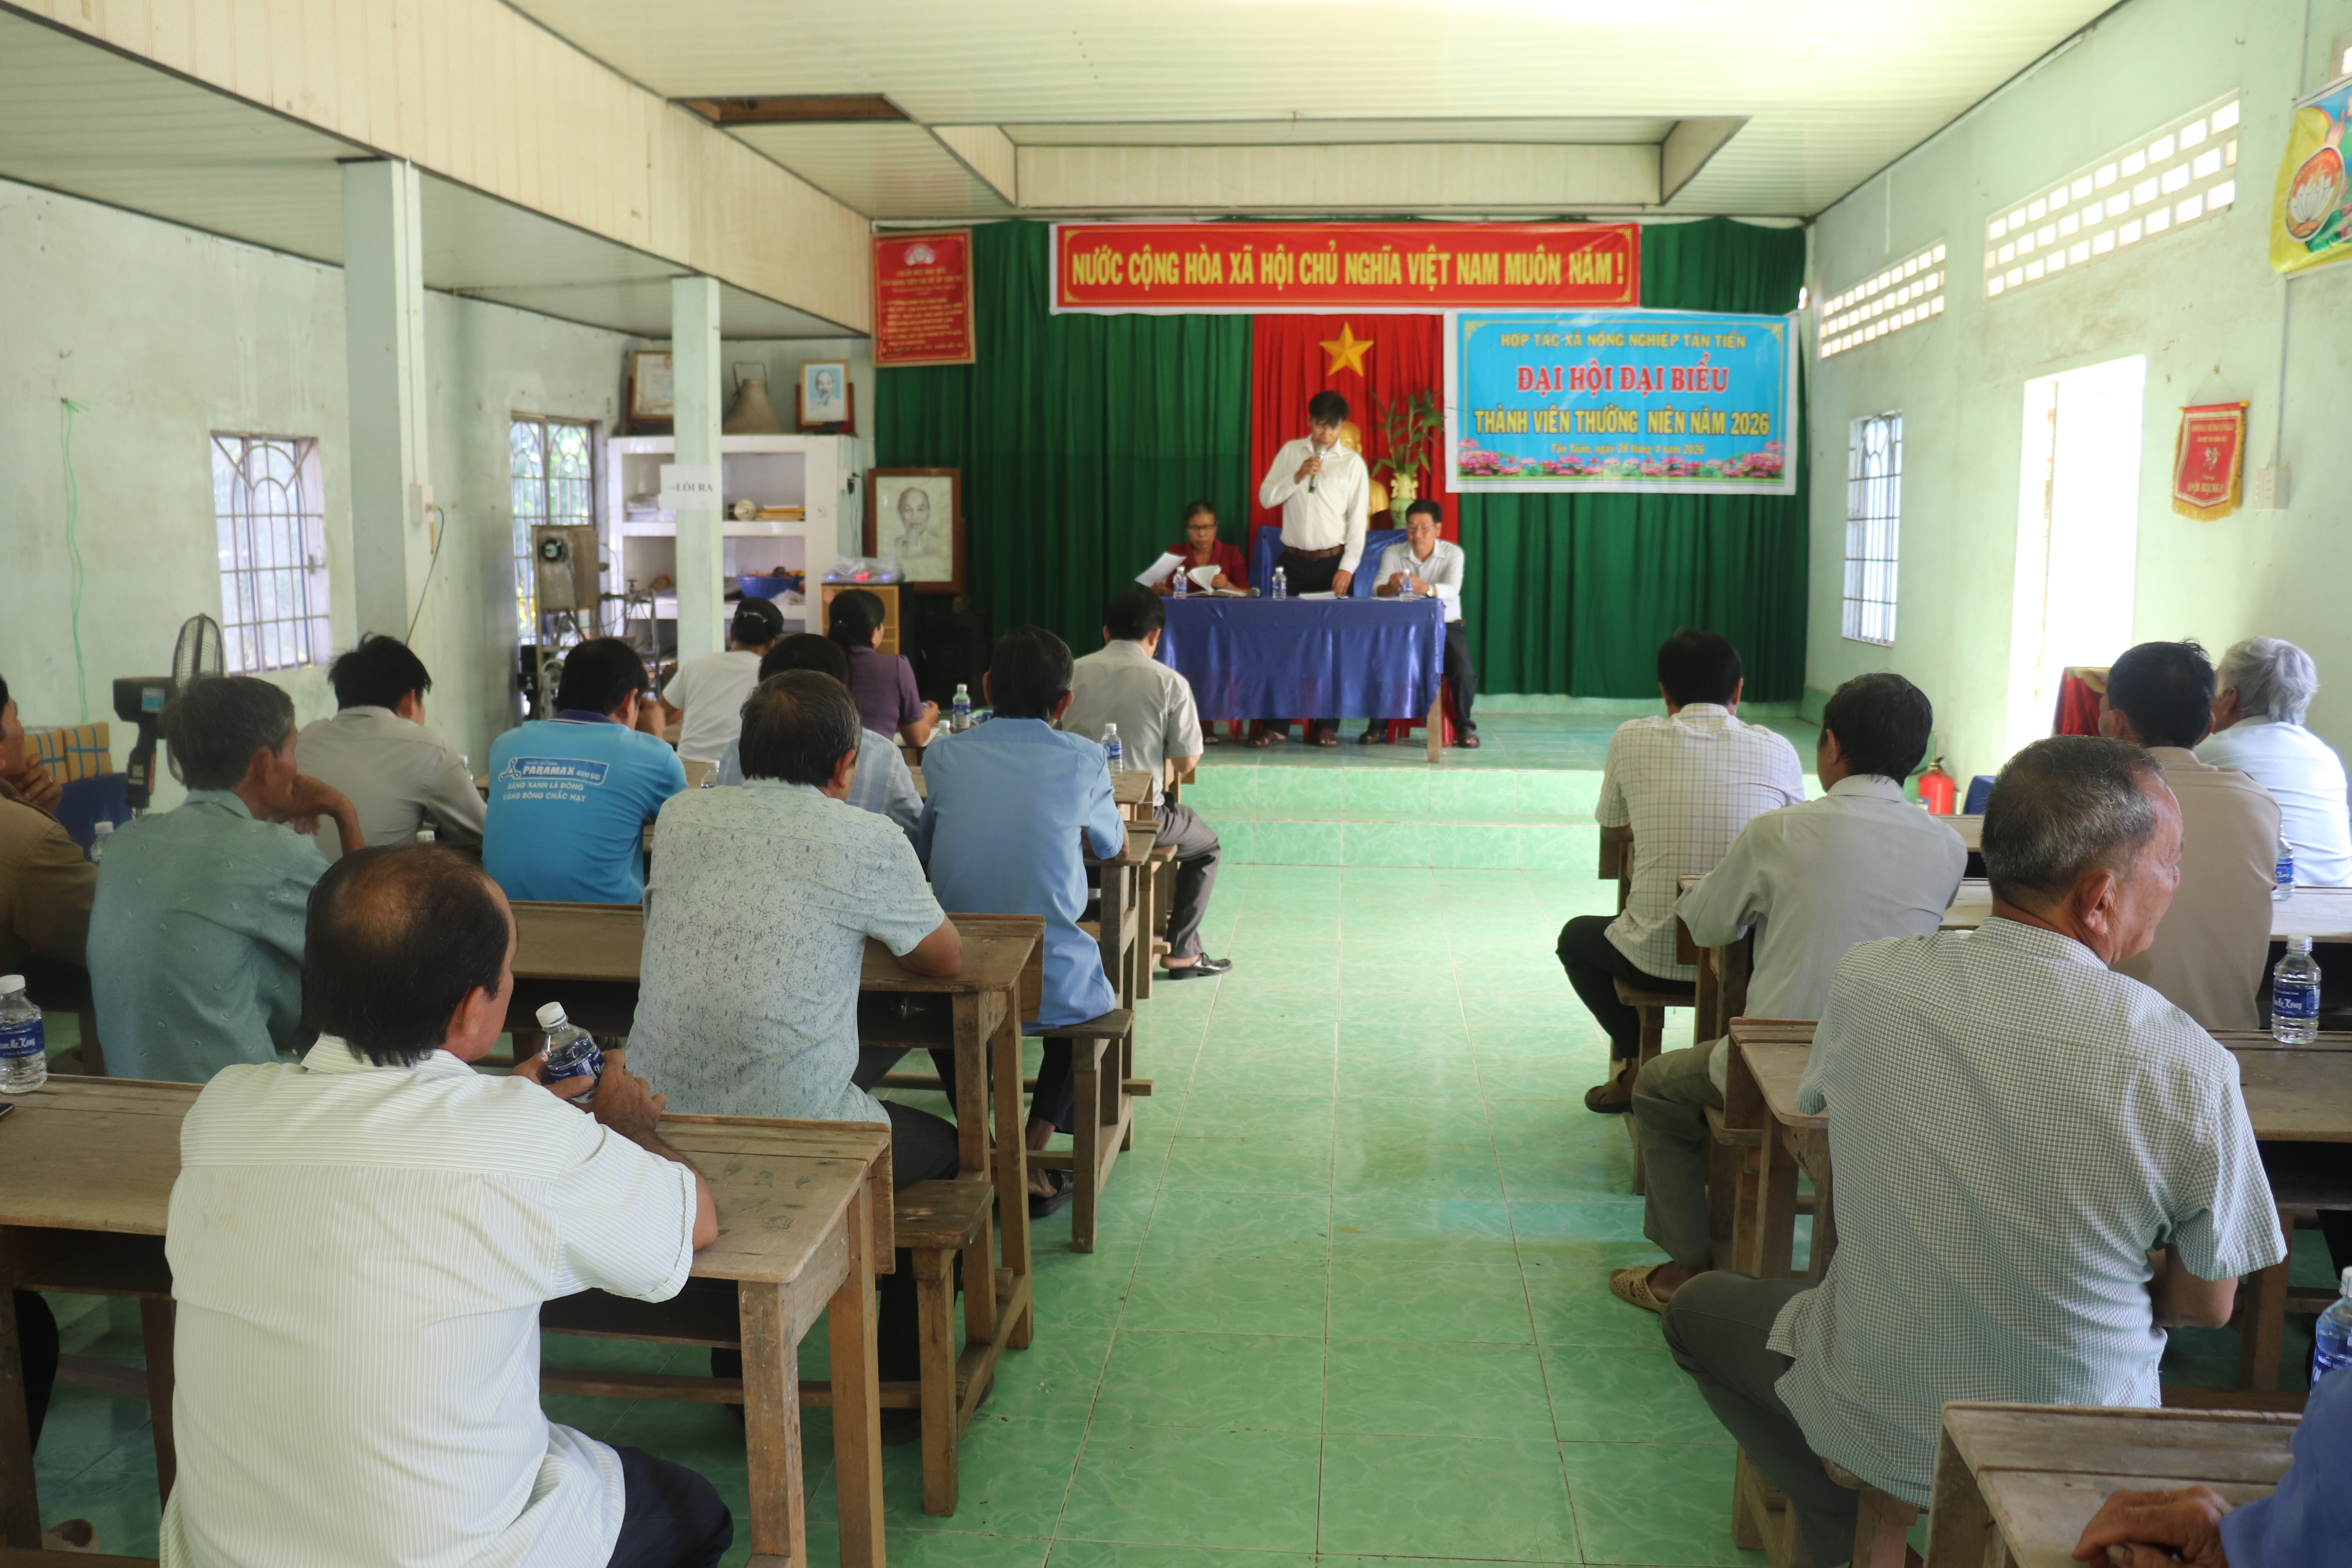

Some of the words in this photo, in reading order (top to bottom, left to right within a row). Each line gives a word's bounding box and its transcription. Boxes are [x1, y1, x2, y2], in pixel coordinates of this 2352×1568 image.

[1073, 244, 1123, 285] NƯỚC
[1128, 243, 1179, 291] CỘNG
[1185, 243, 1223, 285] HÒA
[1229, 244, 1254, 285] XÃ
[1261, 243, 1294, 291] HỘI
[1299, 240, 1338, 285] CHỦ
[1345, 244, 1402, 285] NGHĨA
[1407, 244, 1451, 292] VIỆT
[1457, 252, 1499, 285] NAM
[1504, 243, 1561, 285] MUÔN
[1568, 246, 1612, 285] NĂM
[1617, 252, 1624, 285] !
[1501, 332, 1529, 349] HỢP
[1534, 330, 1560, 347] TÁC
[1564, 330, 1582, 347] XÃ
[1587, 330, 1625, 347] NÔNG
[1628, 330, 1680, 349] NGHIỆP
[1682, 331, 1710, 348] TÂN
[1714, 330, 1746, 348] TIẾN
[1517, 366, 1563, 397] ĐẠI
[1569, 359, 1613, 397] HỘI
[1619, 366, 1665, 397] ĐẠI
[1670, 352, 1730, 392] BIỂU
[1474, 404, 1528, 434] THÀNH
[1532, 404, 1570, 434] VIÊN
[1574, 403, 1639, 434] THƯỜNG
[1648, 404, 1686, 434] NIÊN
[1690, 406, 1725, 435] NĂM
[1730, 412, 1770, 436] 2026
[699, 483, 713, 491] RA
[523, 766, 575, 775] PARAMAX
[570, 794, 586, 803] HẠT
